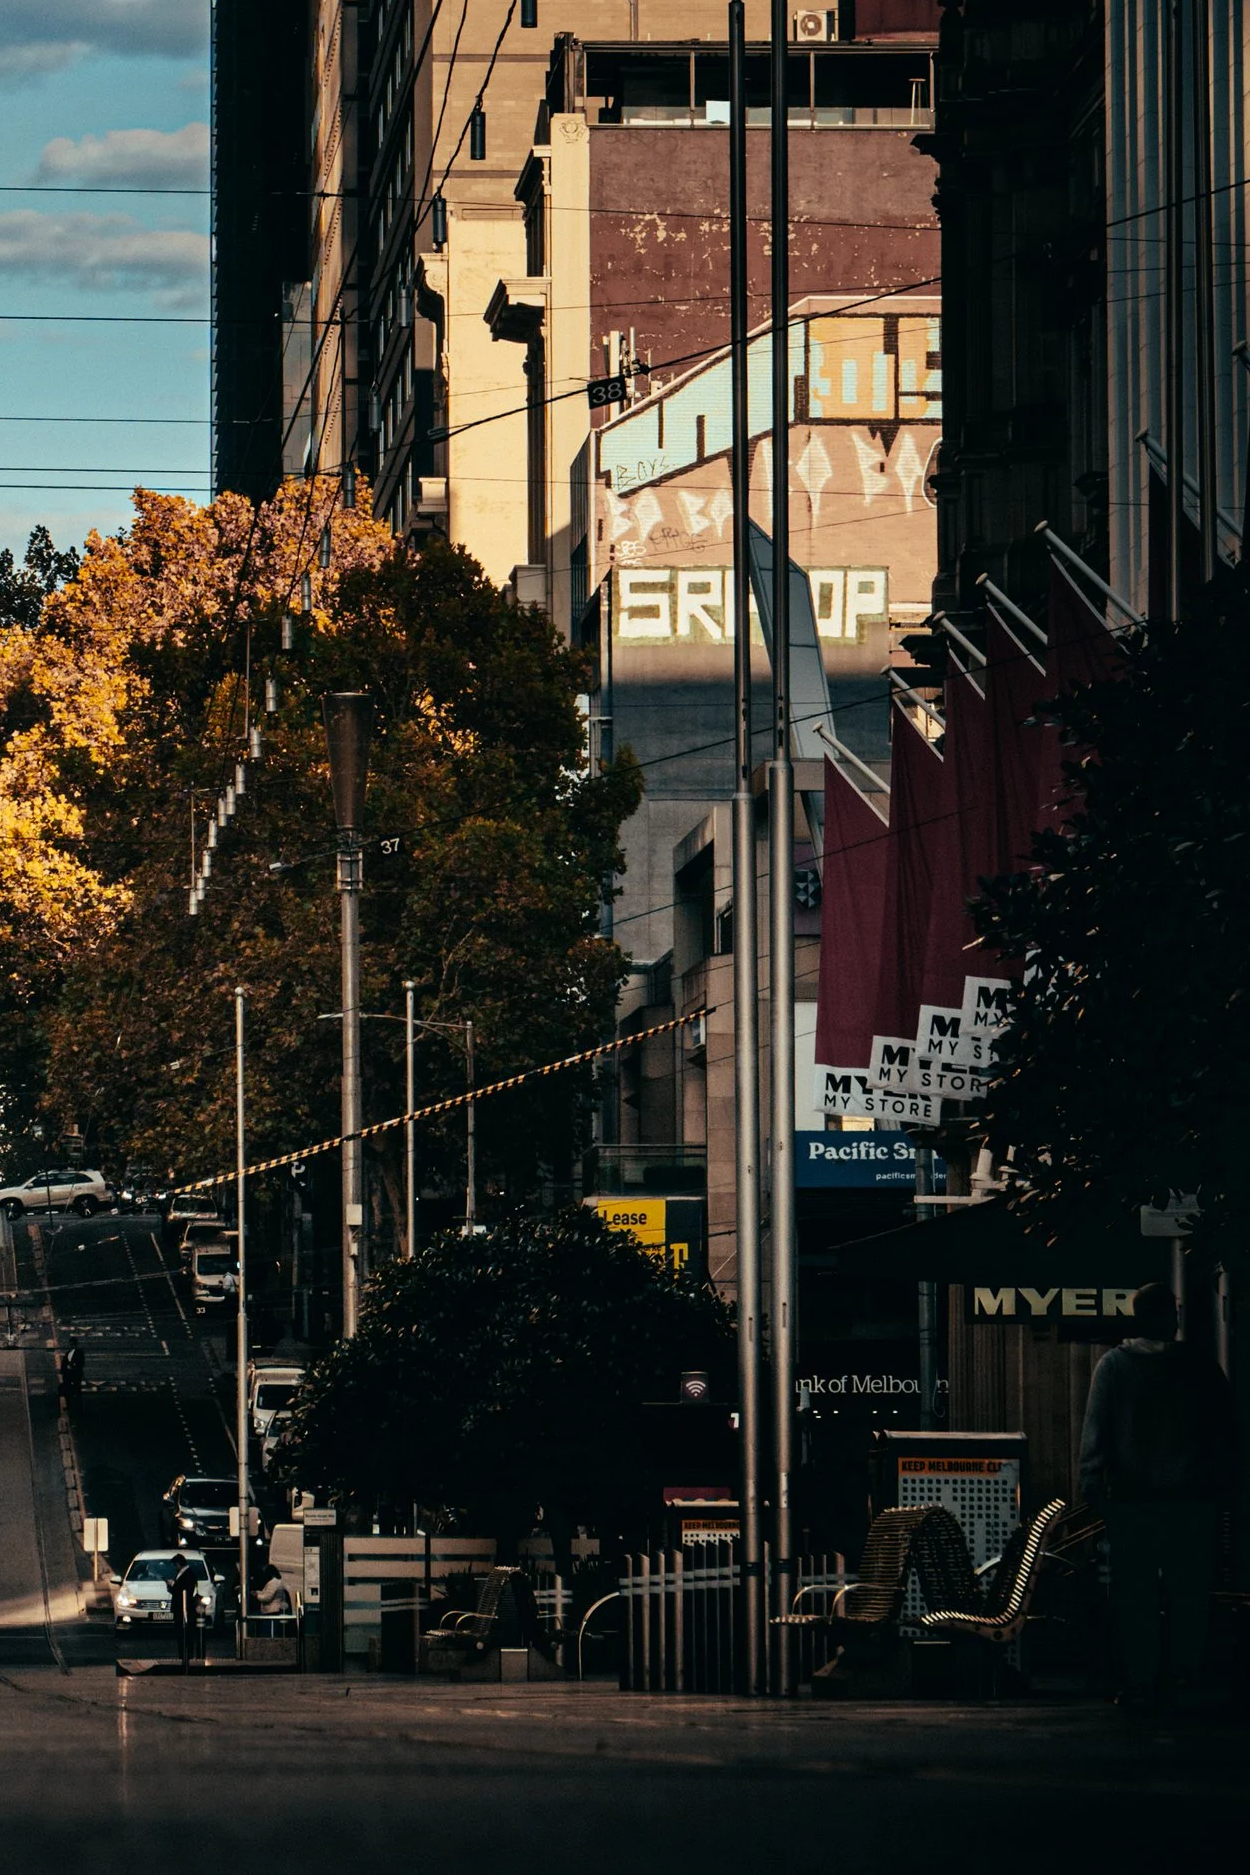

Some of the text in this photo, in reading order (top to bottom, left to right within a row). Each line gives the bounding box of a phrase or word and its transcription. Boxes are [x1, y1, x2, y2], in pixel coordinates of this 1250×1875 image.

[592, 382, 623, 404] 38
[928, 1038, 959, 1056] MY
[879, 1067, 908, 1083] MY
[824, 1094, 932, 1118] MY STORE
[808, 1141, 889, 1161] Pacific
[603, 1209, 648, 1226] Lease
[973, 1287, 1139, 1317] MYER
[828, 1375, 848, 1393] of
[901, 1460, 925, 1471] KEEP
